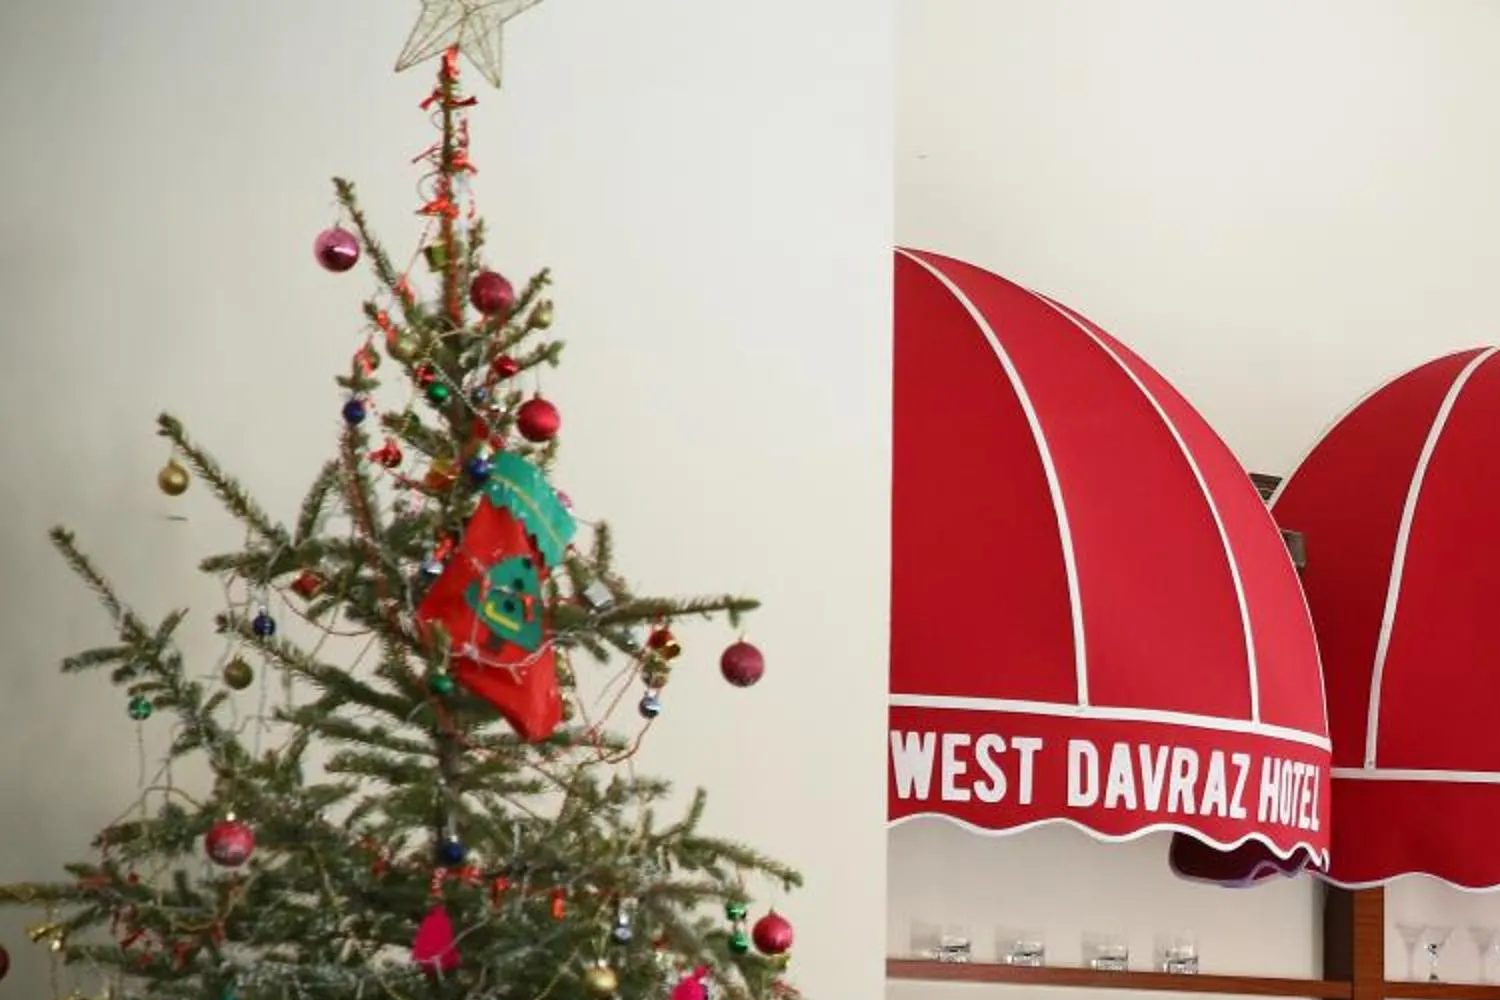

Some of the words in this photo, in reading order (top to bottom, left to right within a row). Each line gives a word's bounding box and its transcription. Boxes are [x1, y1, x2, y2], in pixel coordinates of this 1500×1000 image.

[890, 730, 1043, 805] WEST
[1067, 740, 1250, 820] DAVRAZ
[1257, 756, 1320, 832] HOTEL
